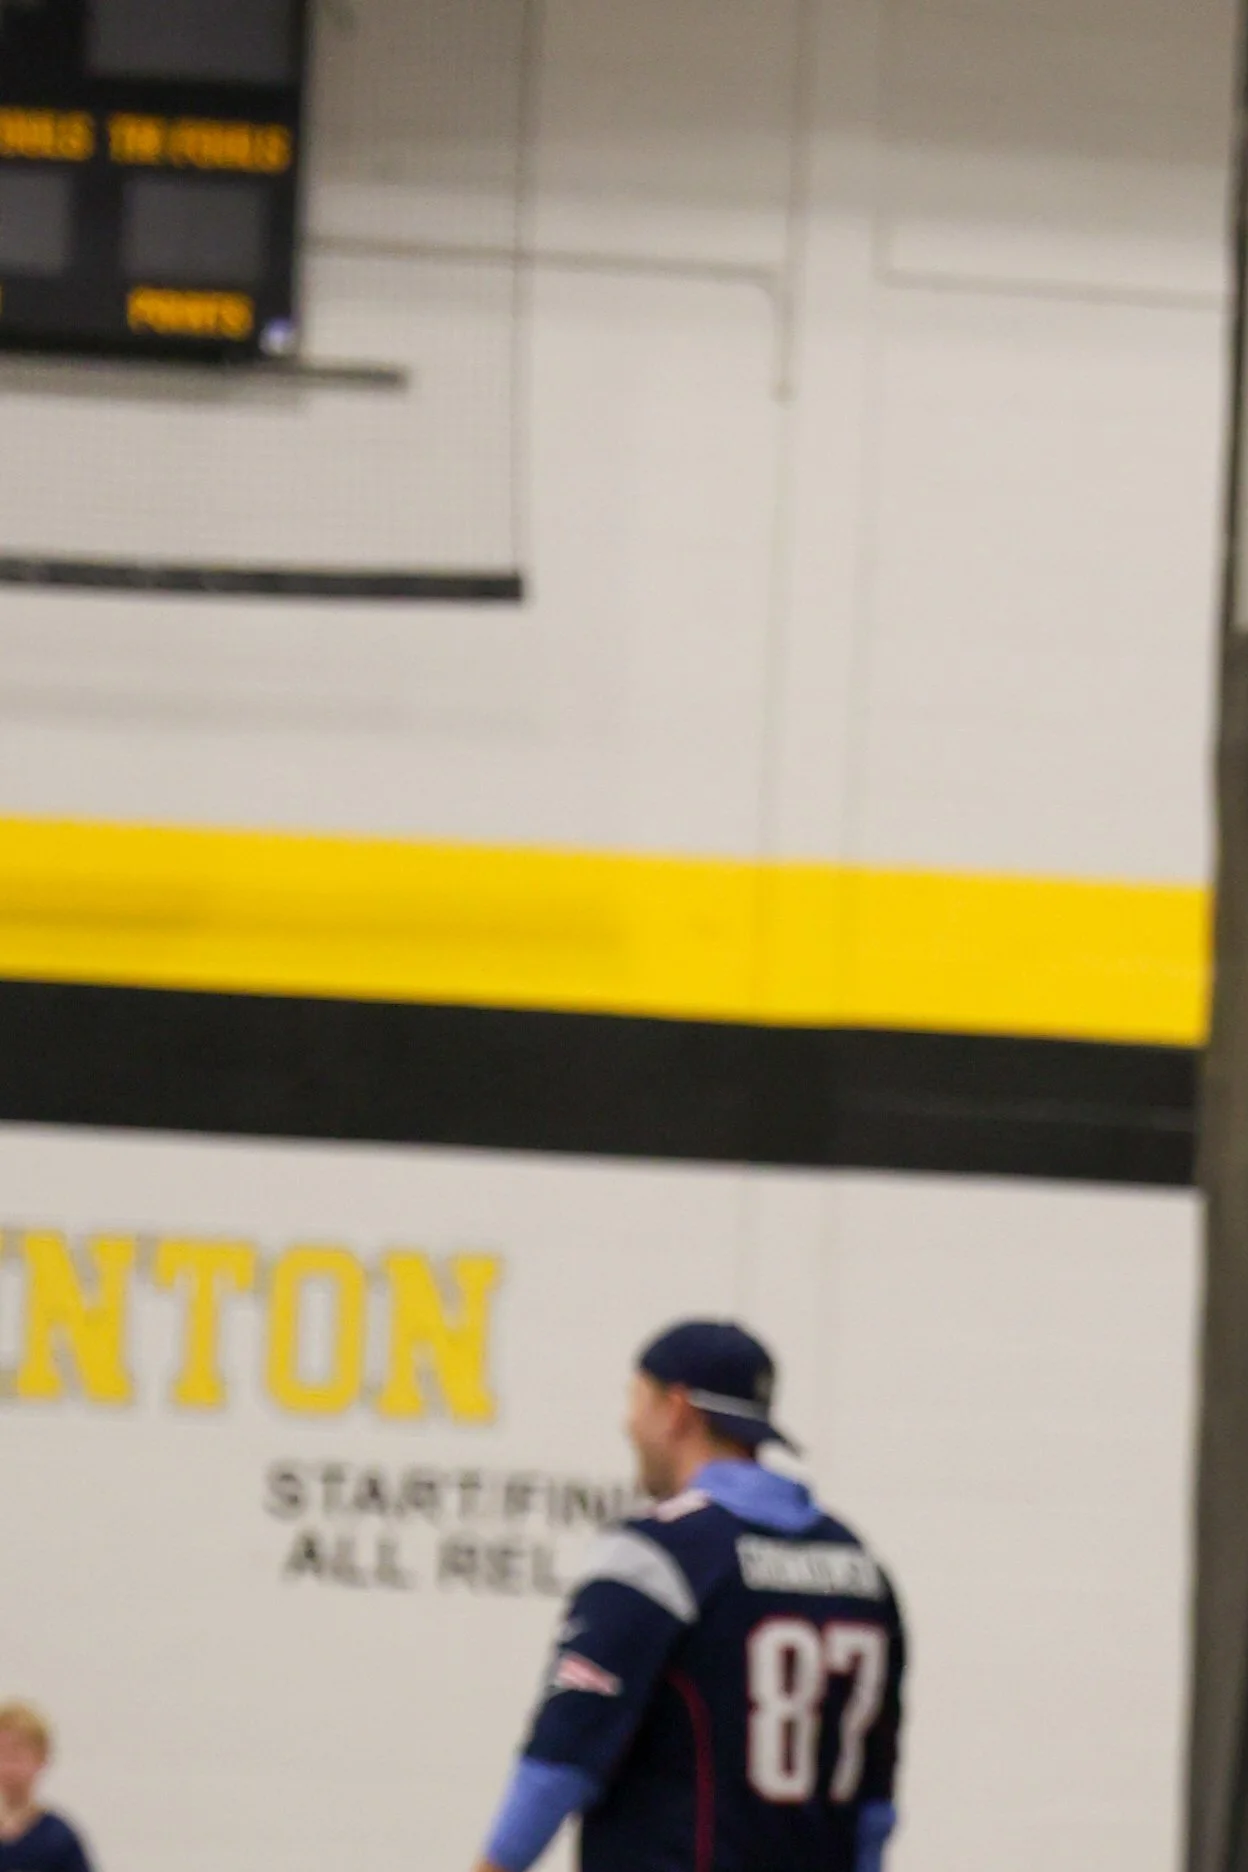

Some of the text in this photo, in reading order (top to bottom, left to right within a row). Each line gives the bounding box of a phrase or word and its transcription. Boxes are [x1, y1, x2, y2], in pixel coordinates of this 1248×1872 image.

[0, 109, 95, 162] OULS
[0, 1229, 503, 1424] NTON
[281, 1527, 565, 1596] ALL REL
[744, 1615, 888, 1804] 87
